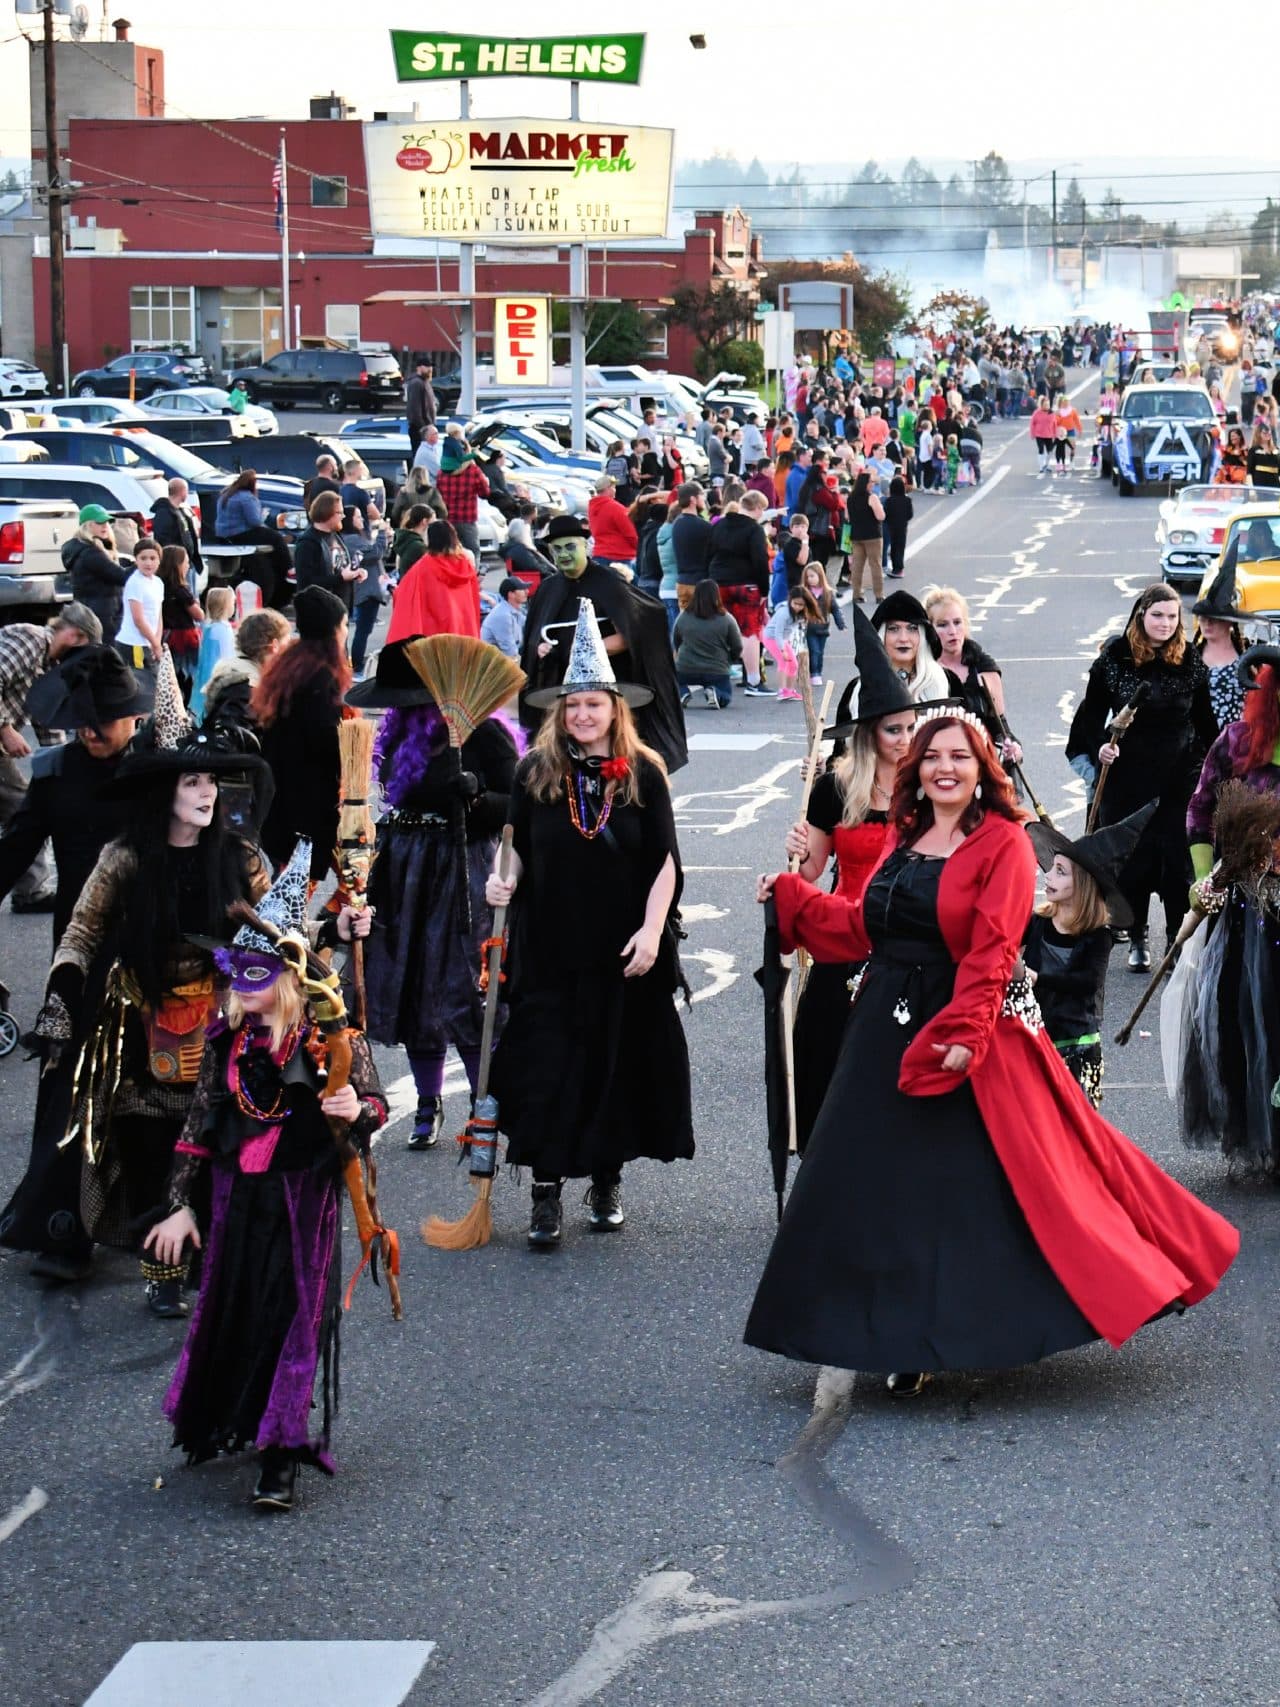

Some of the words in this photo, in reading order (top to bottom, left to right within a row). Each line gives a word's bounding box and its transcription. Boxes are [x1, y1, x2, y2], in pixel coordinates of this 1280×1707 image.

[412, 42, 465, 71] ST.
[478, 44, 627, 74] HELENS
[469, 132, 629, 160] MARKET
[574, 149, 637, 178] fresh
[419, 187, 474, 200] WHATS
[492, 187, 510, 200] ON
[423, 202, 492, 216] ECLIPTIC
[504, 202, 558, 217] PEACH
[576, 203, 610, 217] SOUR
[424, 217, 481, 231] PELICAN
[495, 218, 568, 232] TSUNAMI
[581, 219, 631, 233] STOUT
[505, 303, 538, 376] DELI
[1144, 462, 1202, 481] CFSH
